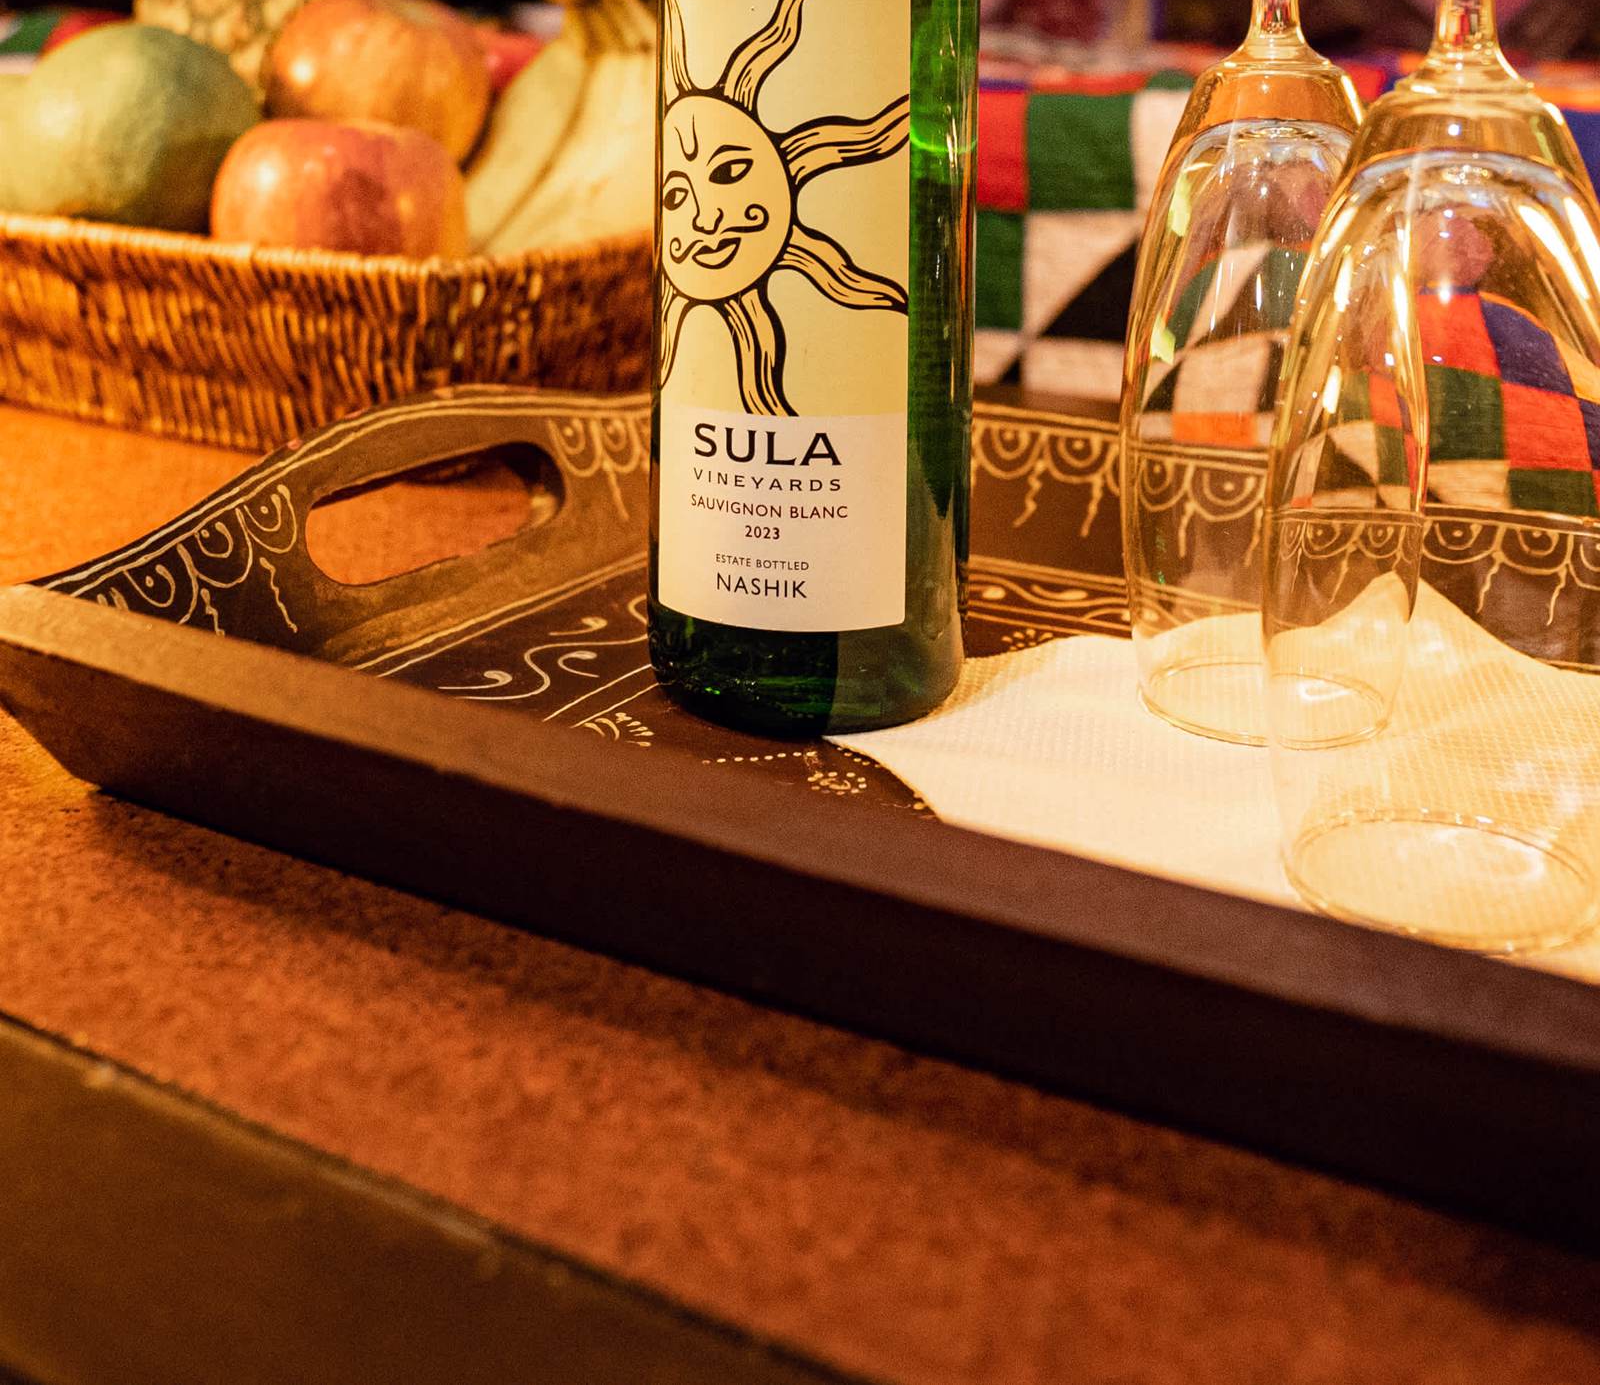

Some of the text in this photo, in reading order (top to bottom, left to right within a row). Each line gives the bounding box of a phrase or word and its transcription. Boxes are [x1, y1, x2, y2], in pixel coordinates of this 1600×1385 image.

[693, 422, 842, 466] SULA
[693, 467, 842, 491] VINEYARDS
[690, 493, 848, 519] SAUVIGNON BLANC
[744, 525, 781, 540] 2023
[715, 553, 809, 571] ESTATE BOTTLED
[716, 572, 807, 598] NASHIK
